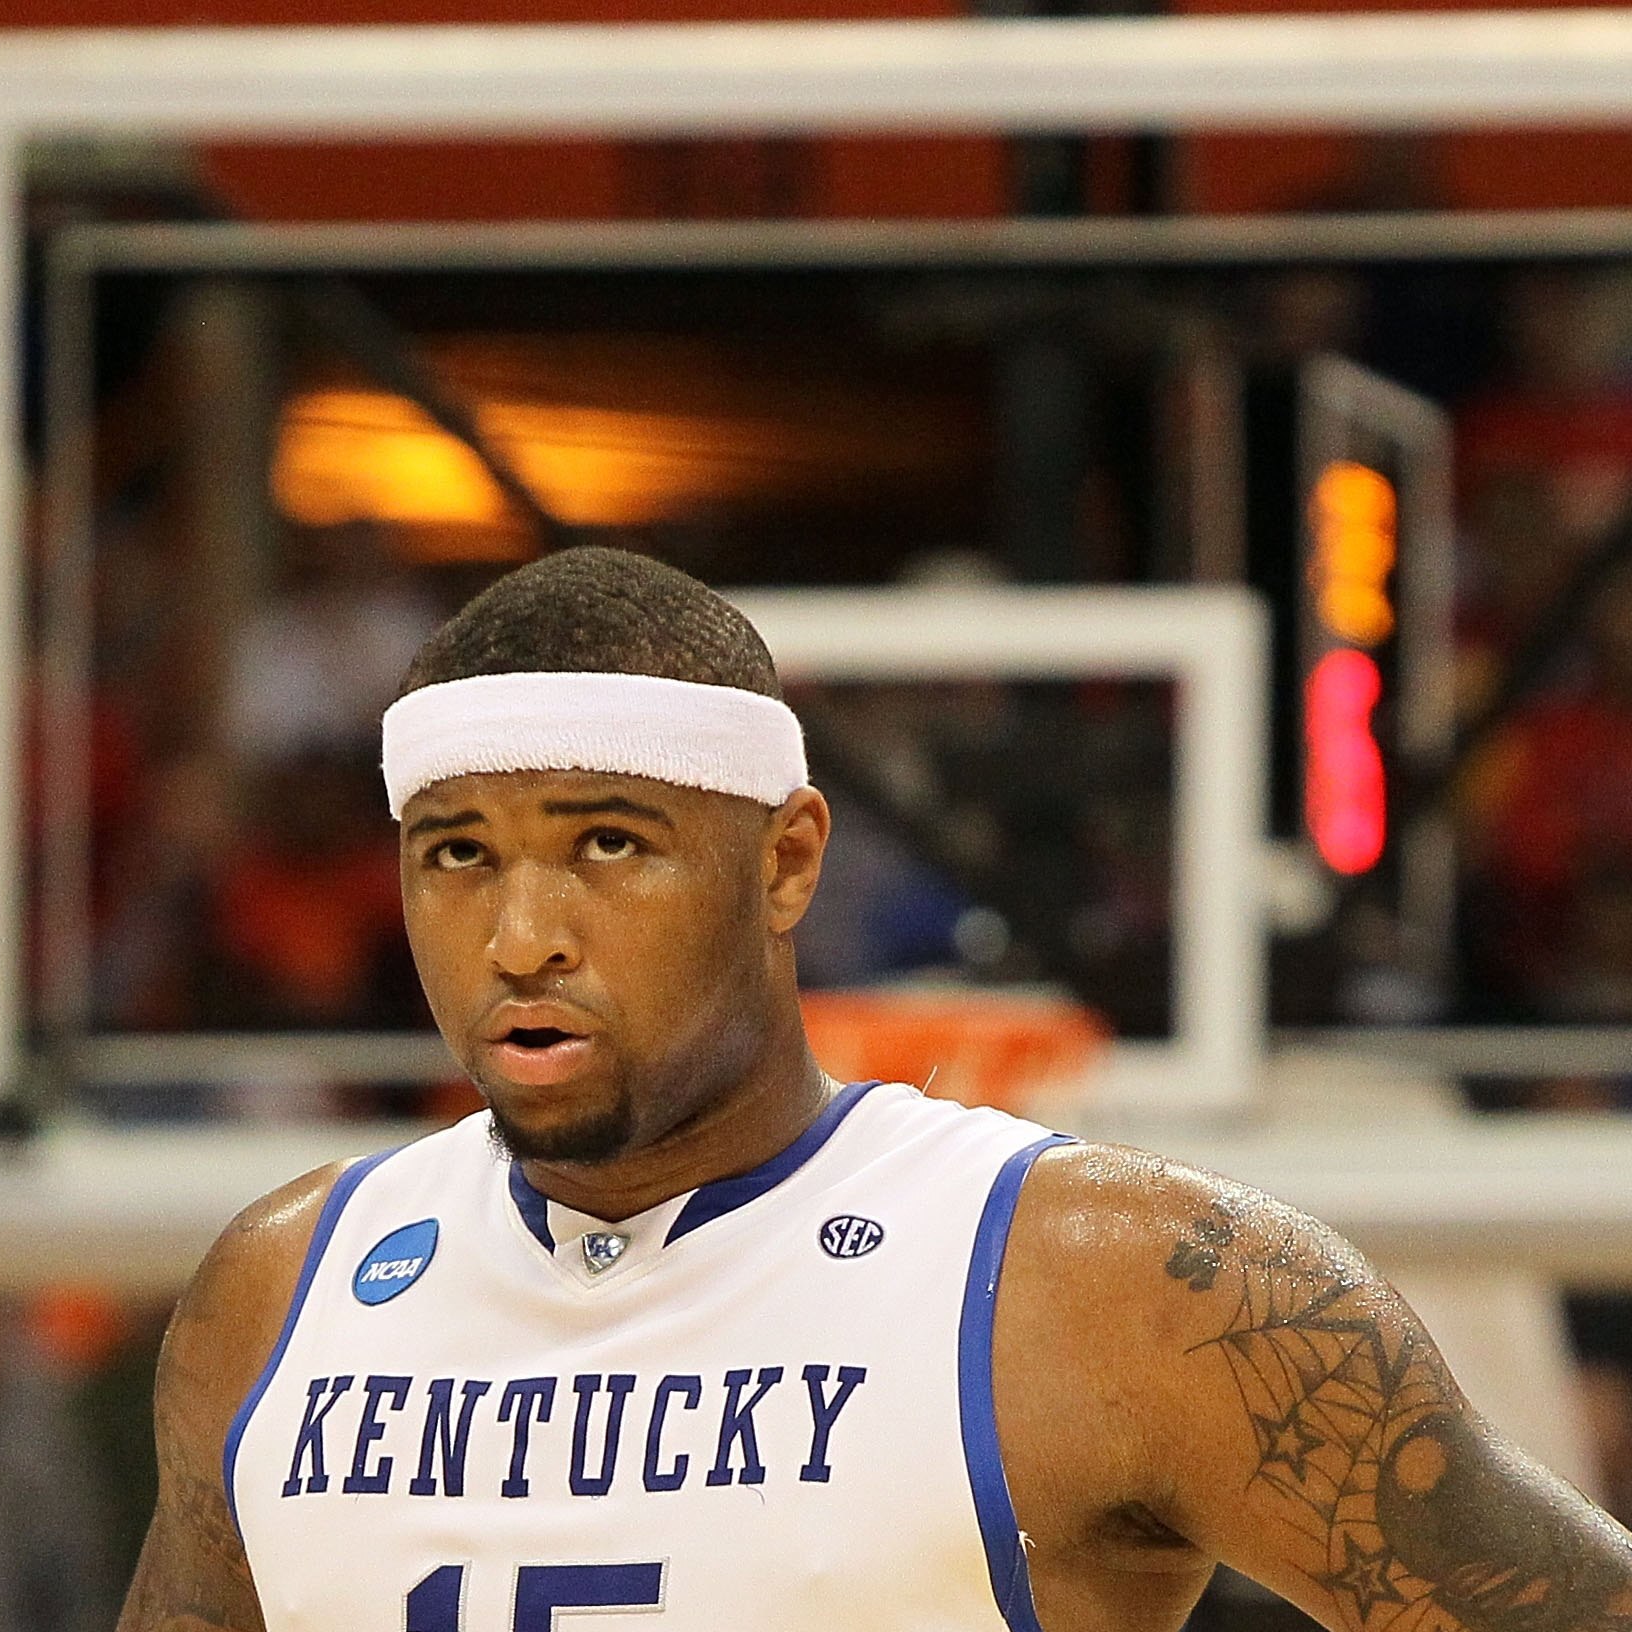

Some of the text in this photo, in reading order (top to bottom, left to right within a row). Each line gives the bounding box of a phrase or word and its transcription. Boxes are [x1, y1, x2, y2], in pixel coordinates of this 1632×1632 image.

[823, 1217, 881, 1256] SEC
[360, 1256, 424, 1283] NCAA
[281, 1363, 868, 1499] KENTUCKY
